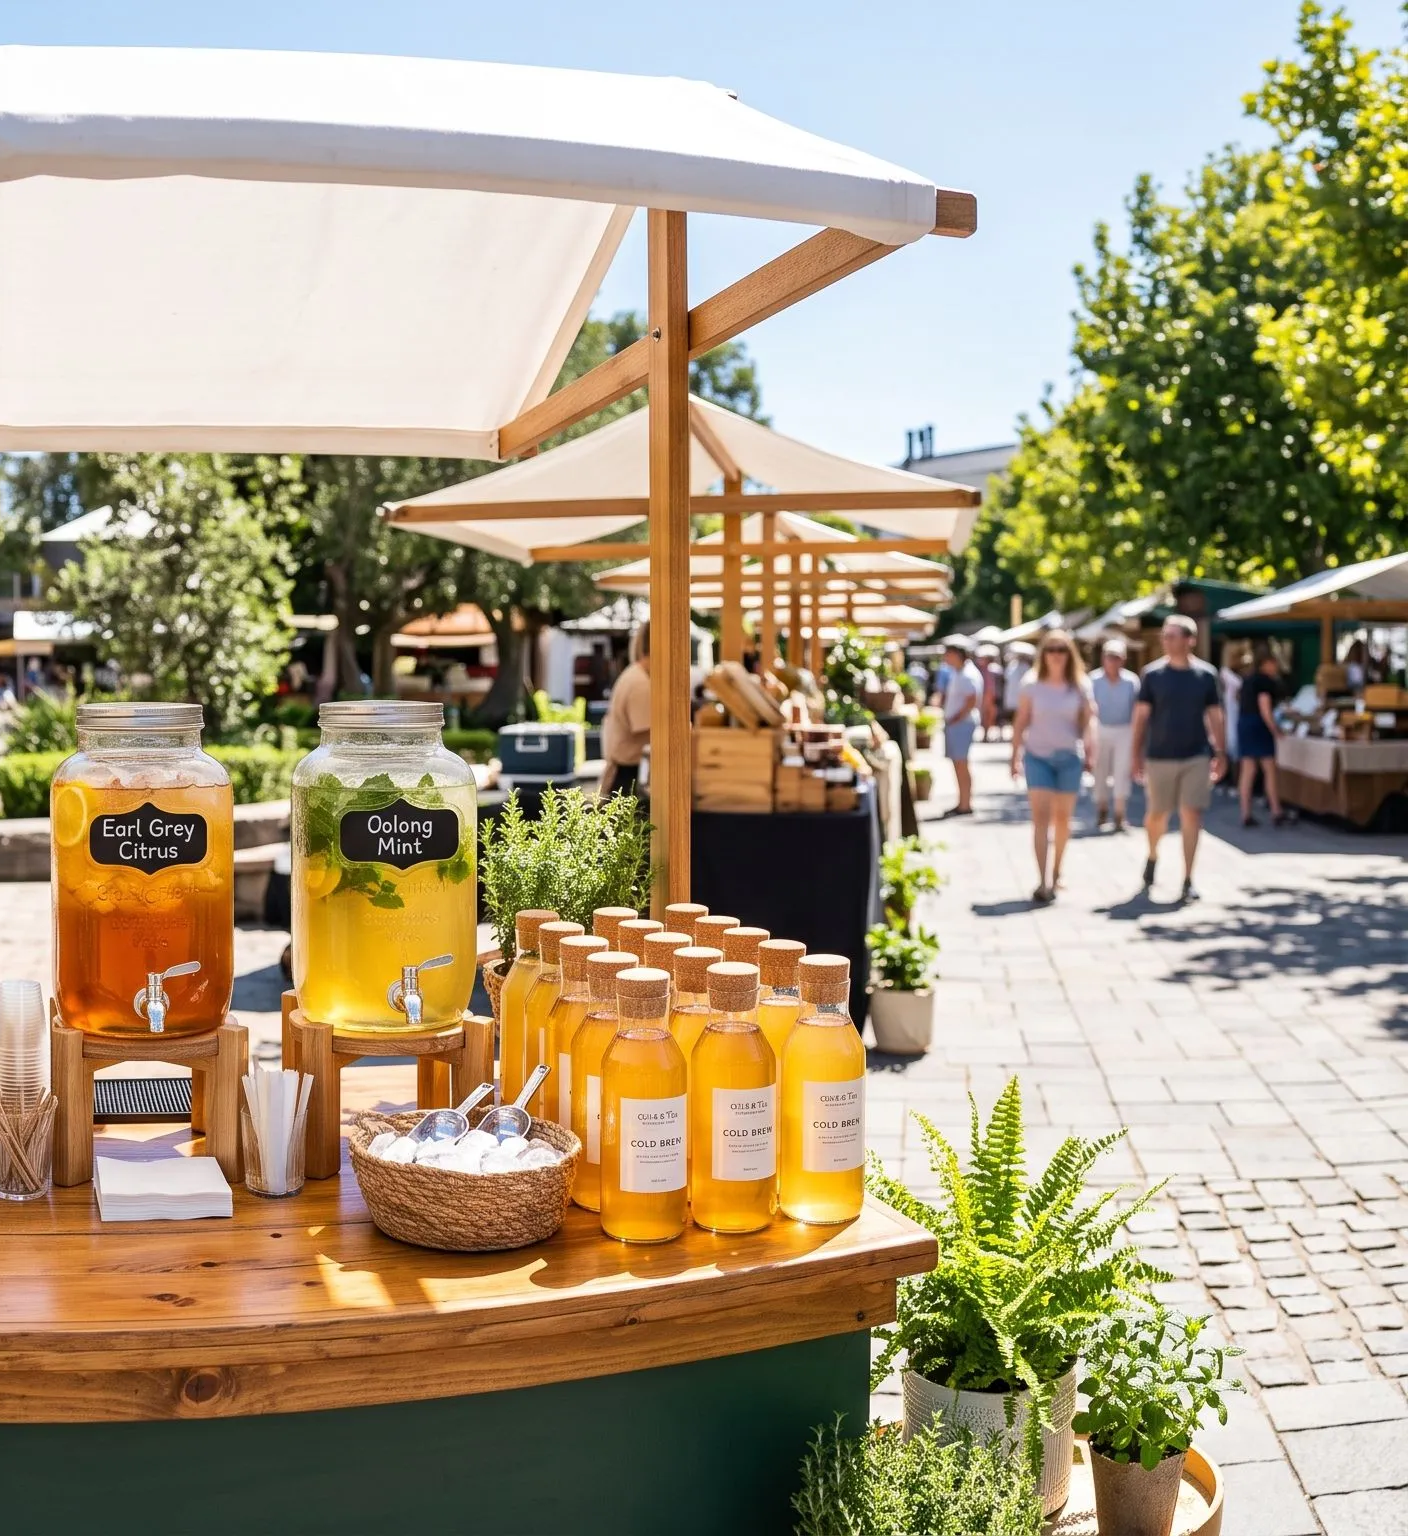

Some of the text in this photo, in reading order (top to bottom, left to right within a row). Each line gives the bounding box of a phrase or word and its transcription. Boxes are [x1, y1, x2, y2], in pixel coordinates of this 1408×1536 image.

[103, 818, 195, 843] Earl Grey
[367, 814, 433, 839] Oolong
[119, 841, 178, 860] Citrus
[377, 837, 423, 856] Mint
[722, 1126, 774, 1137] COLD BREW
[813, 1120, 839, 1129] COLD
[630, 1139, 657, 1148] COLD
